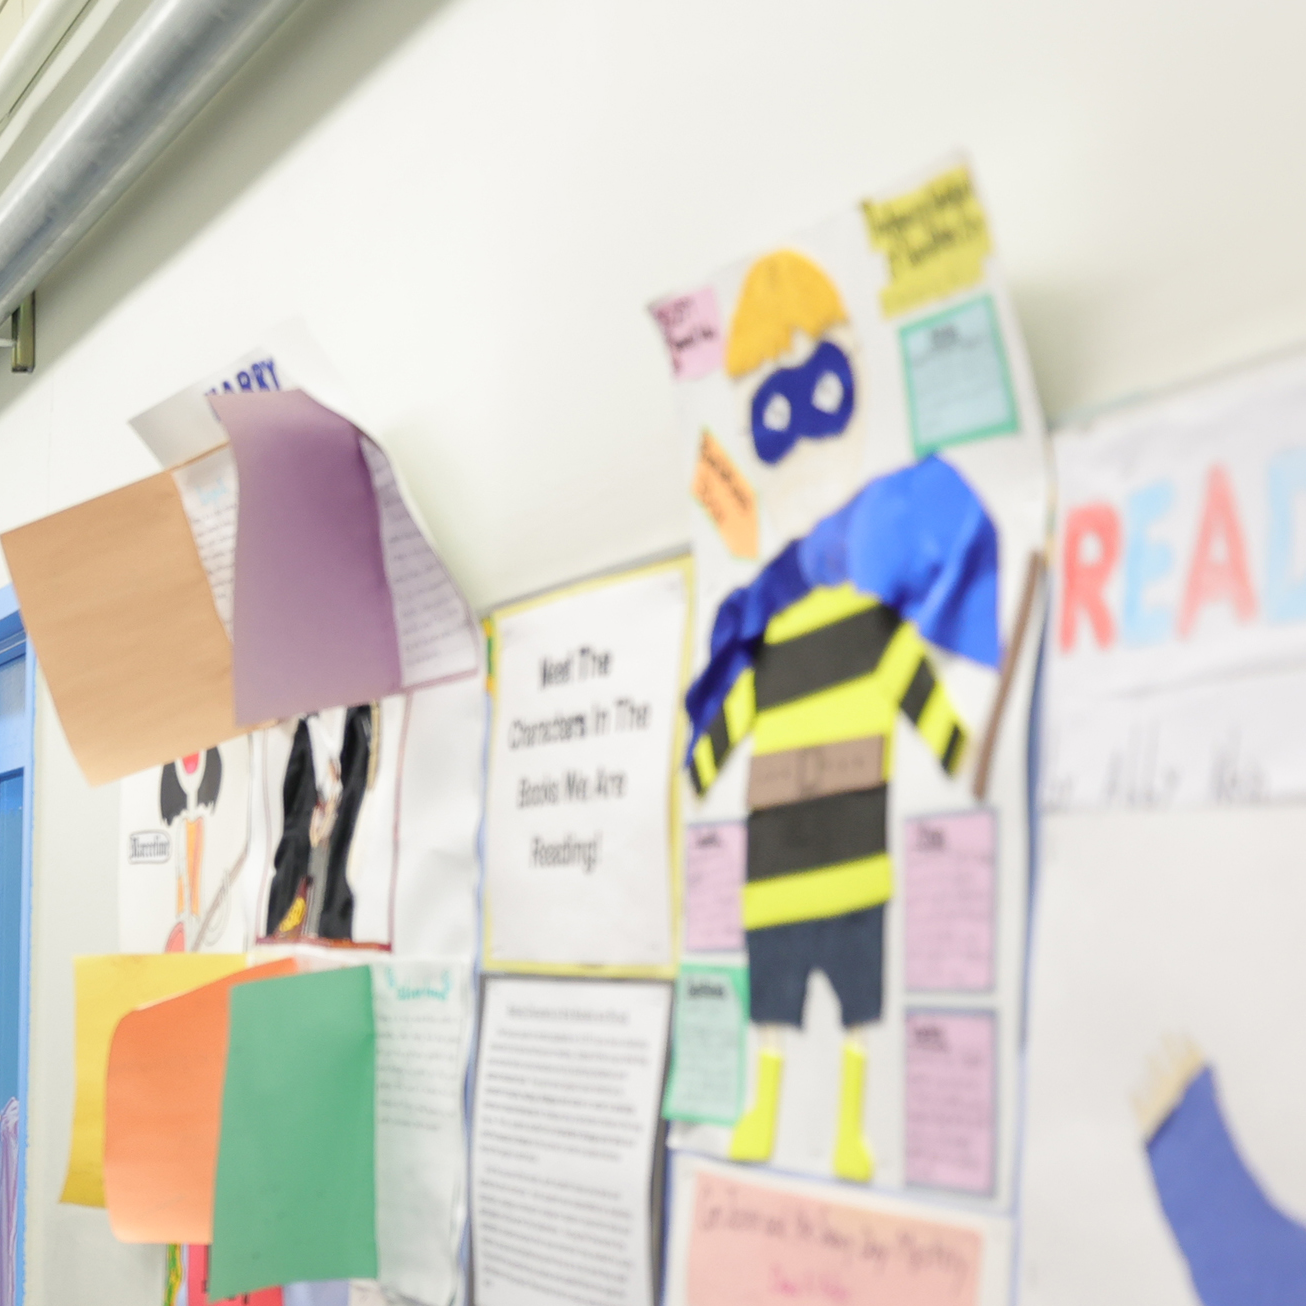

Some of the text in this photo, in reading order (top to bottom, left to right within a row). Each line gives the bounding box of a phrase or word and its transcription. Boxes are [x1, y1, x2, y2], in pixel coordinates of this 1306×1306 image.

[541, 646, 610, 690] Meet The
[510, 699, 650, 750] Characters In The
[518, 768, 625, 809] Books We Are
[532, 835, 600, 873] Reading!
